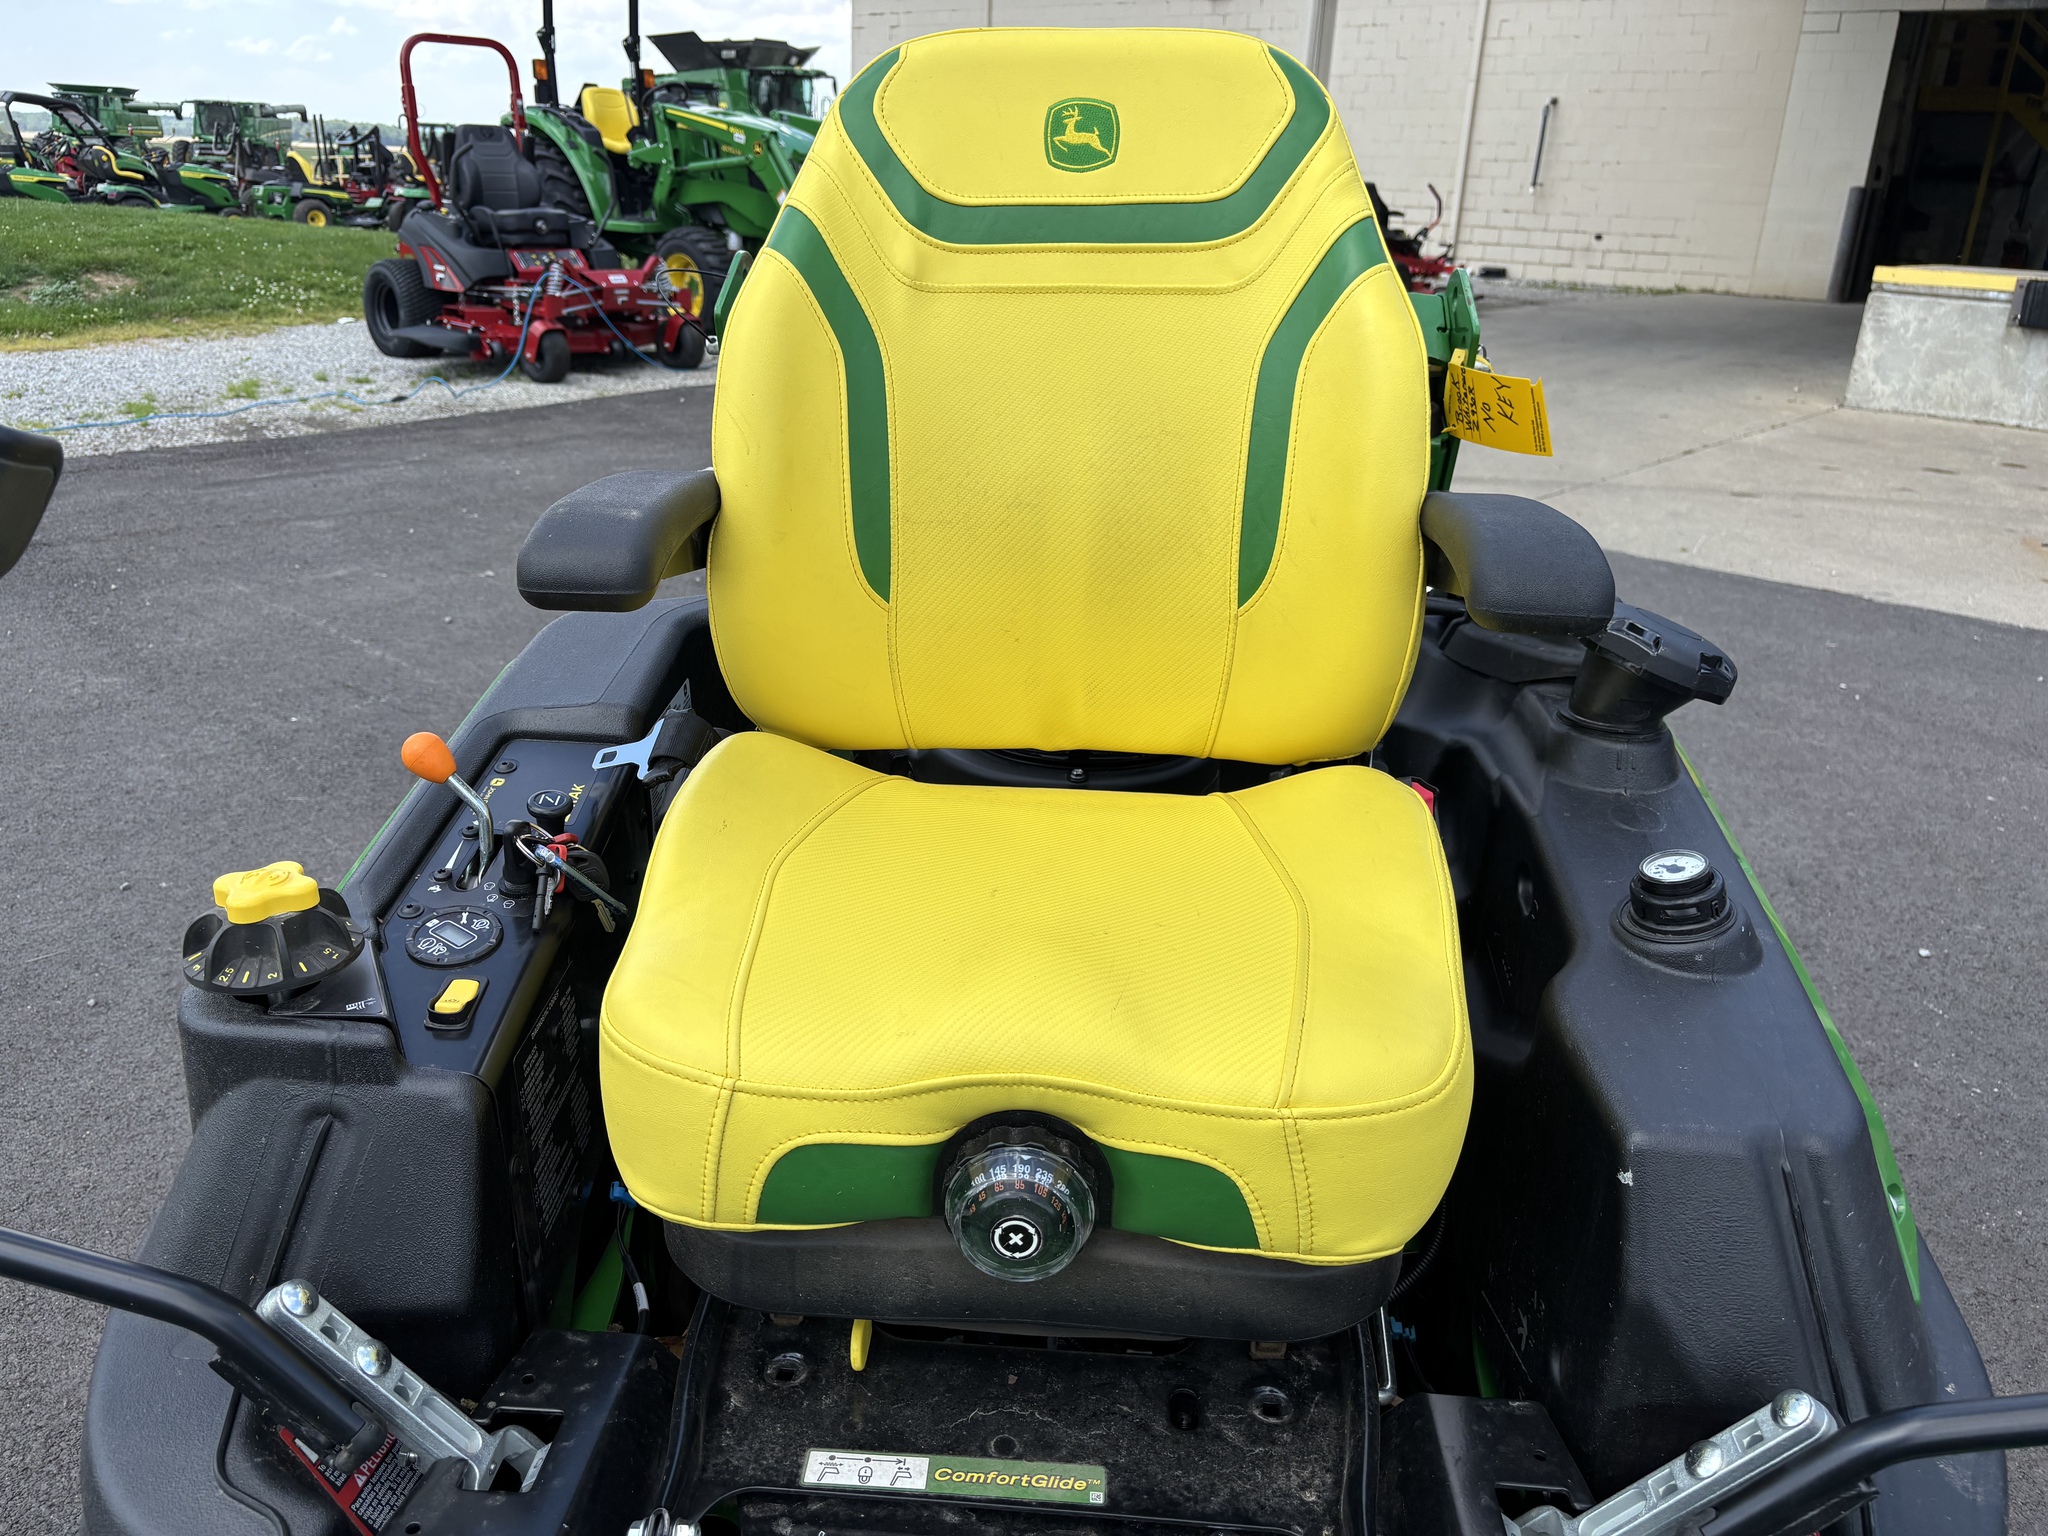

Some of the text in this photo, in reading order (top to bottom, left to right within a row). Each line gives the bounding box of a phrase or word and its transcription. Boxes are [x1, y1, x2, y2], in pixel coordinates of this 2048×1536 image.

[1490, 376, 1519, 426] KEY
[1481, 401, 1496, 433] NO
[322, 947, 339, 961] 1.5
[218, 967, 235, 982] 2.5
[267, 971, 278, 980] 2
[989, 1164, 1007, 1179] 145
[1012, 1164, 1031, 1174] 190
[994, 1181, 1005, 1193] 65
[1014, 1180, 1026, 1190] 85
[1034, 1182, 1049, 1198] 105
[1051, 1195, 1062, 1212] 125
[350, 1496, 364, 1512] Para
[359, 1481, 375, 1500] evitar
[356, 1489, 377, 1516] causadas
[373, 1481, 384, 1493] por
